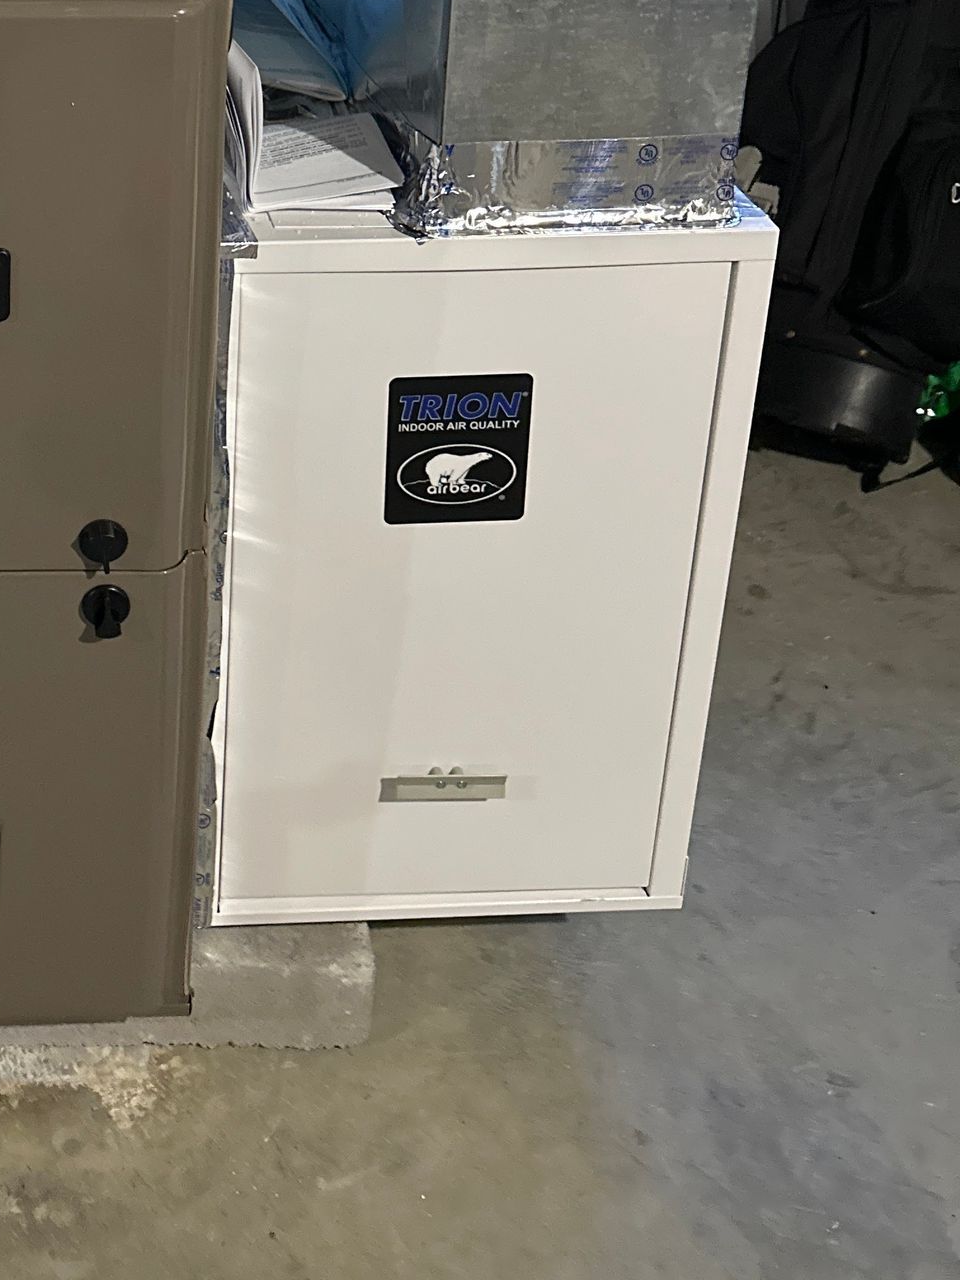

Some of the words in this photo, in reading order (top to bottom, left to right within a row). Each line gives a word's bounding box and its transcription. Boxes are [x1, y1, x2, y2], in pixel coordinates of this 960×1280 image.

[399, 391, 523, 421] TRION
[398, 422, 444, 432] INDOOR
[446, 421, 467, 431] AIR
[469, 419, 520, 430] QUALITY
[426, 482, 487, 495] airbear
